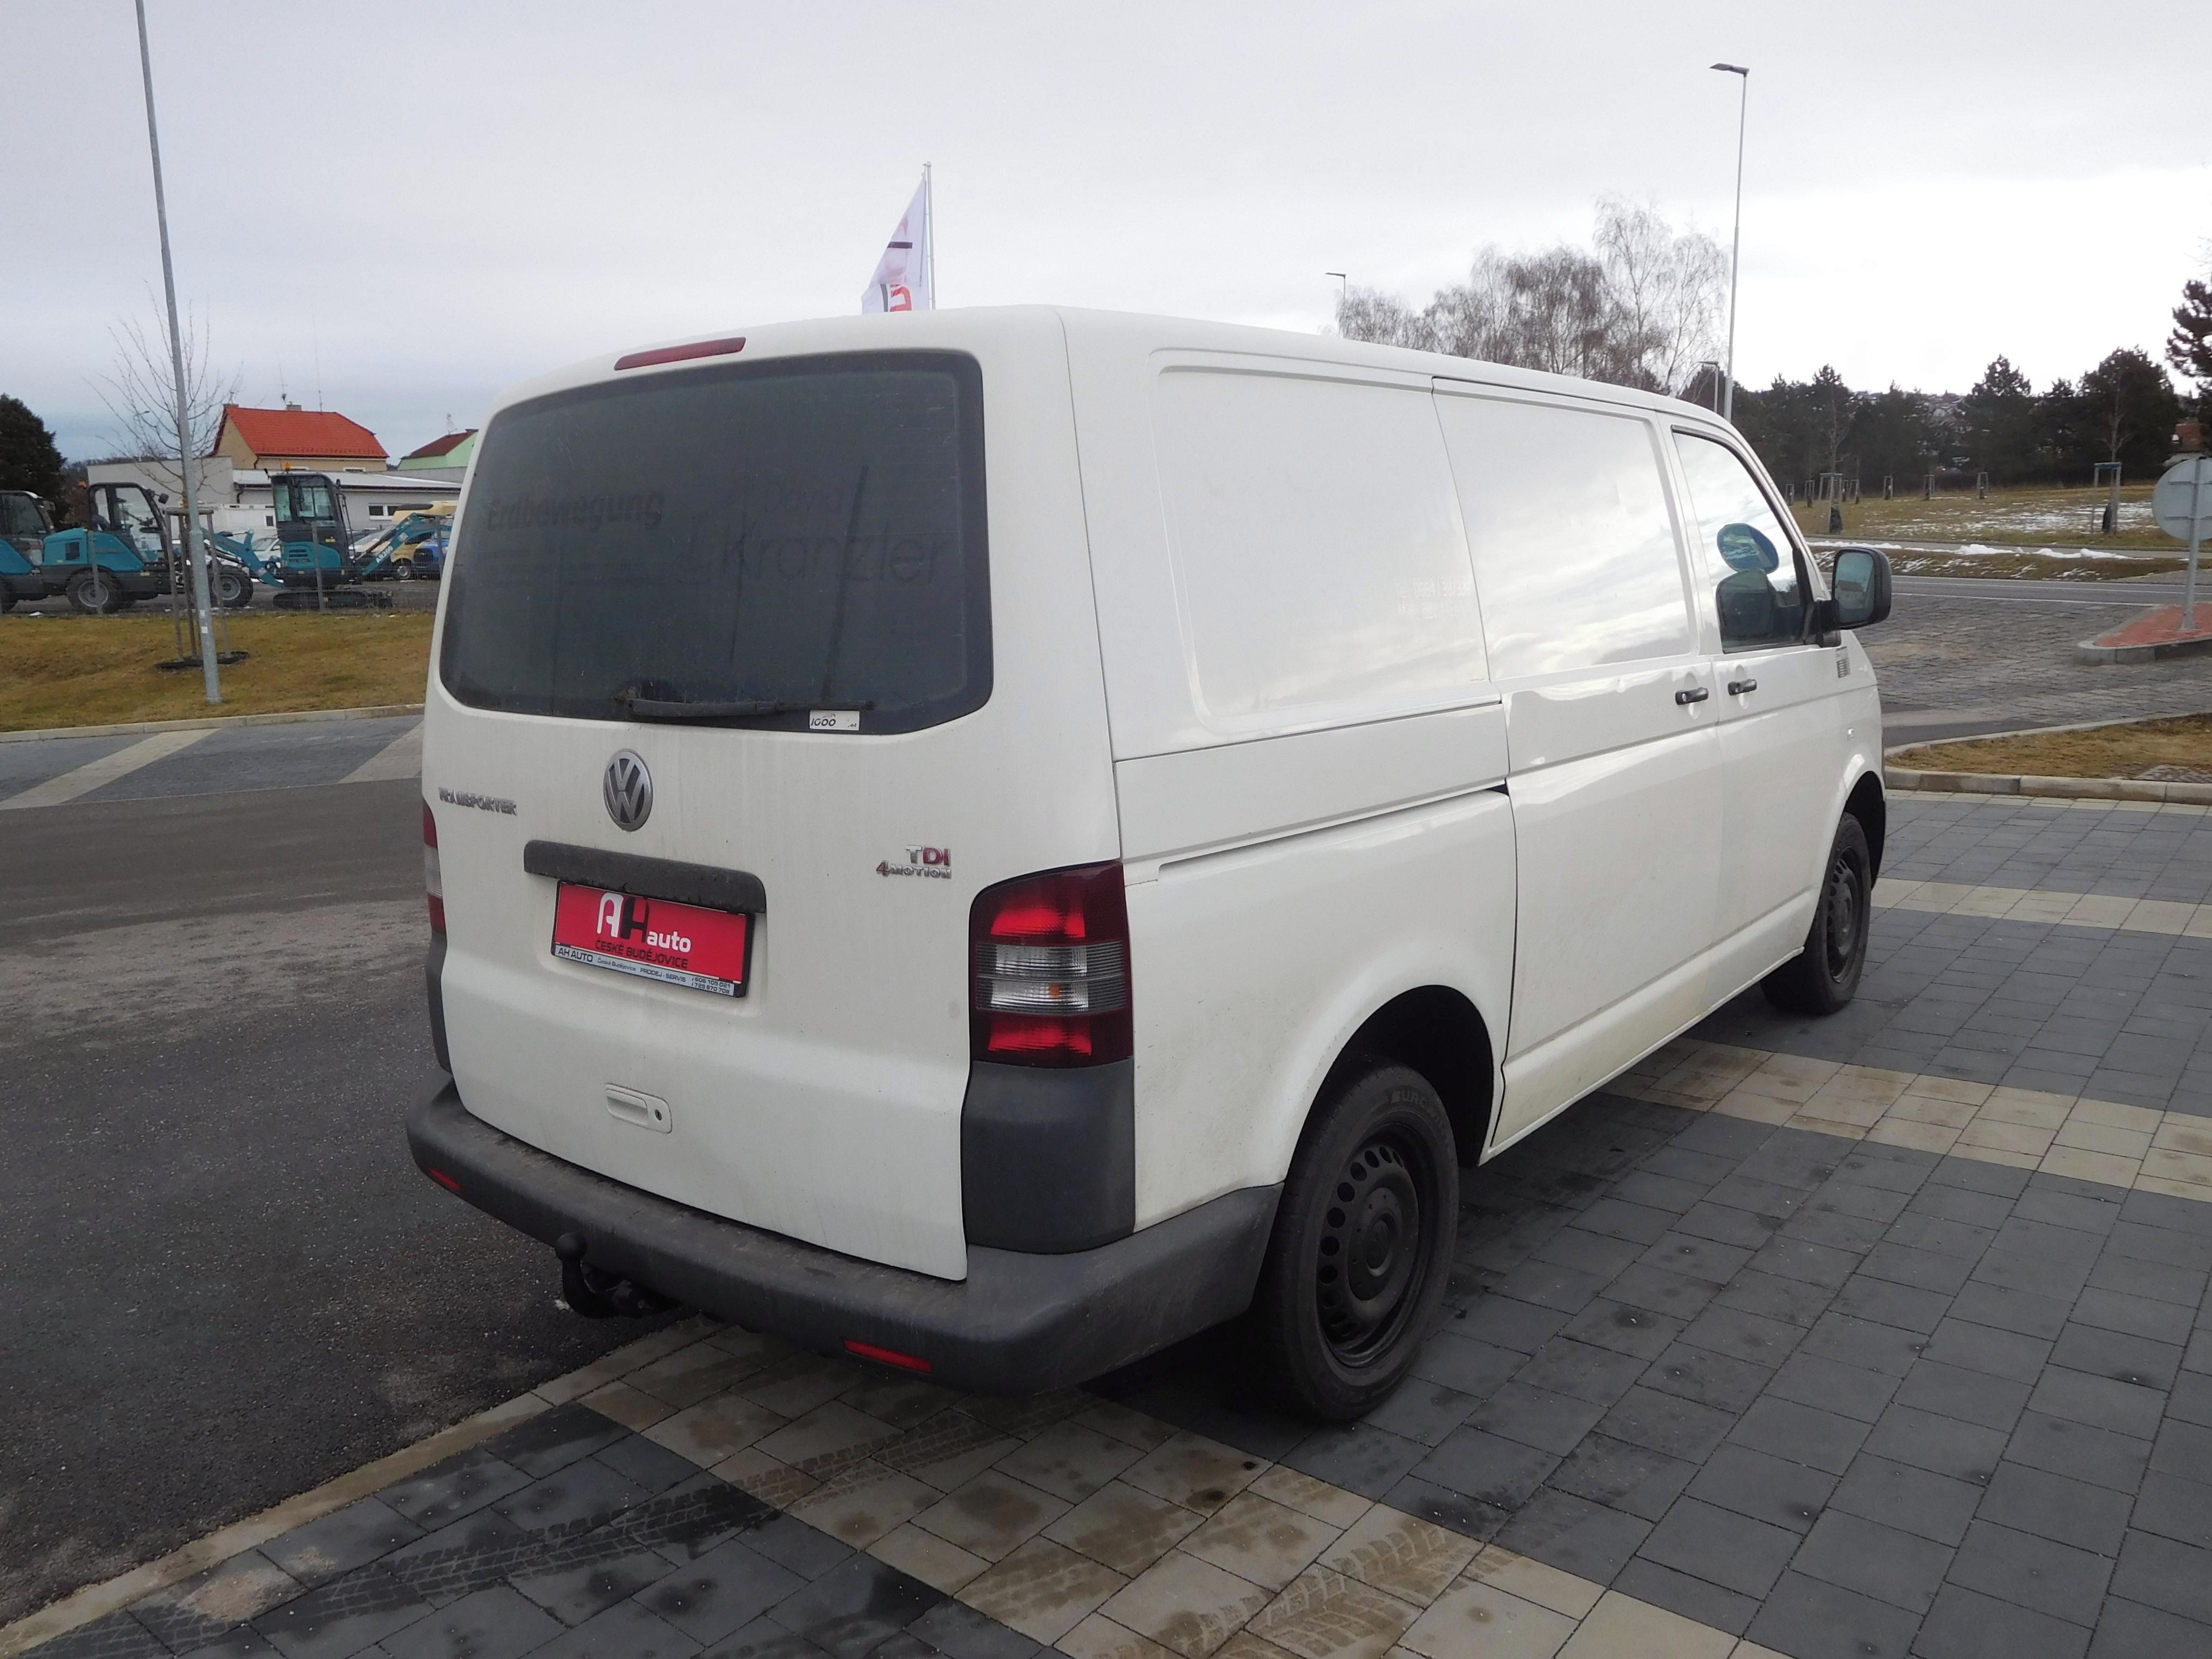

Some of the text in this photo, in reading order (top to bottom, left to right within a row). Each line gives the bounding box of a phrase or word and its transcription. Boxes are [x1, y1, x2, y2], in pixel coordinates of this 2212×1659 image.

[905, 845, 950, 867] TDI
[876, 860, 952, 879] 4MOTION
[647, 931, 691, 953] auto
[558, 947, 594, 962] AH AUTO
[640, 967, 662, 977] PRODEJ
[665, 973, 686, 983] SERVIS
